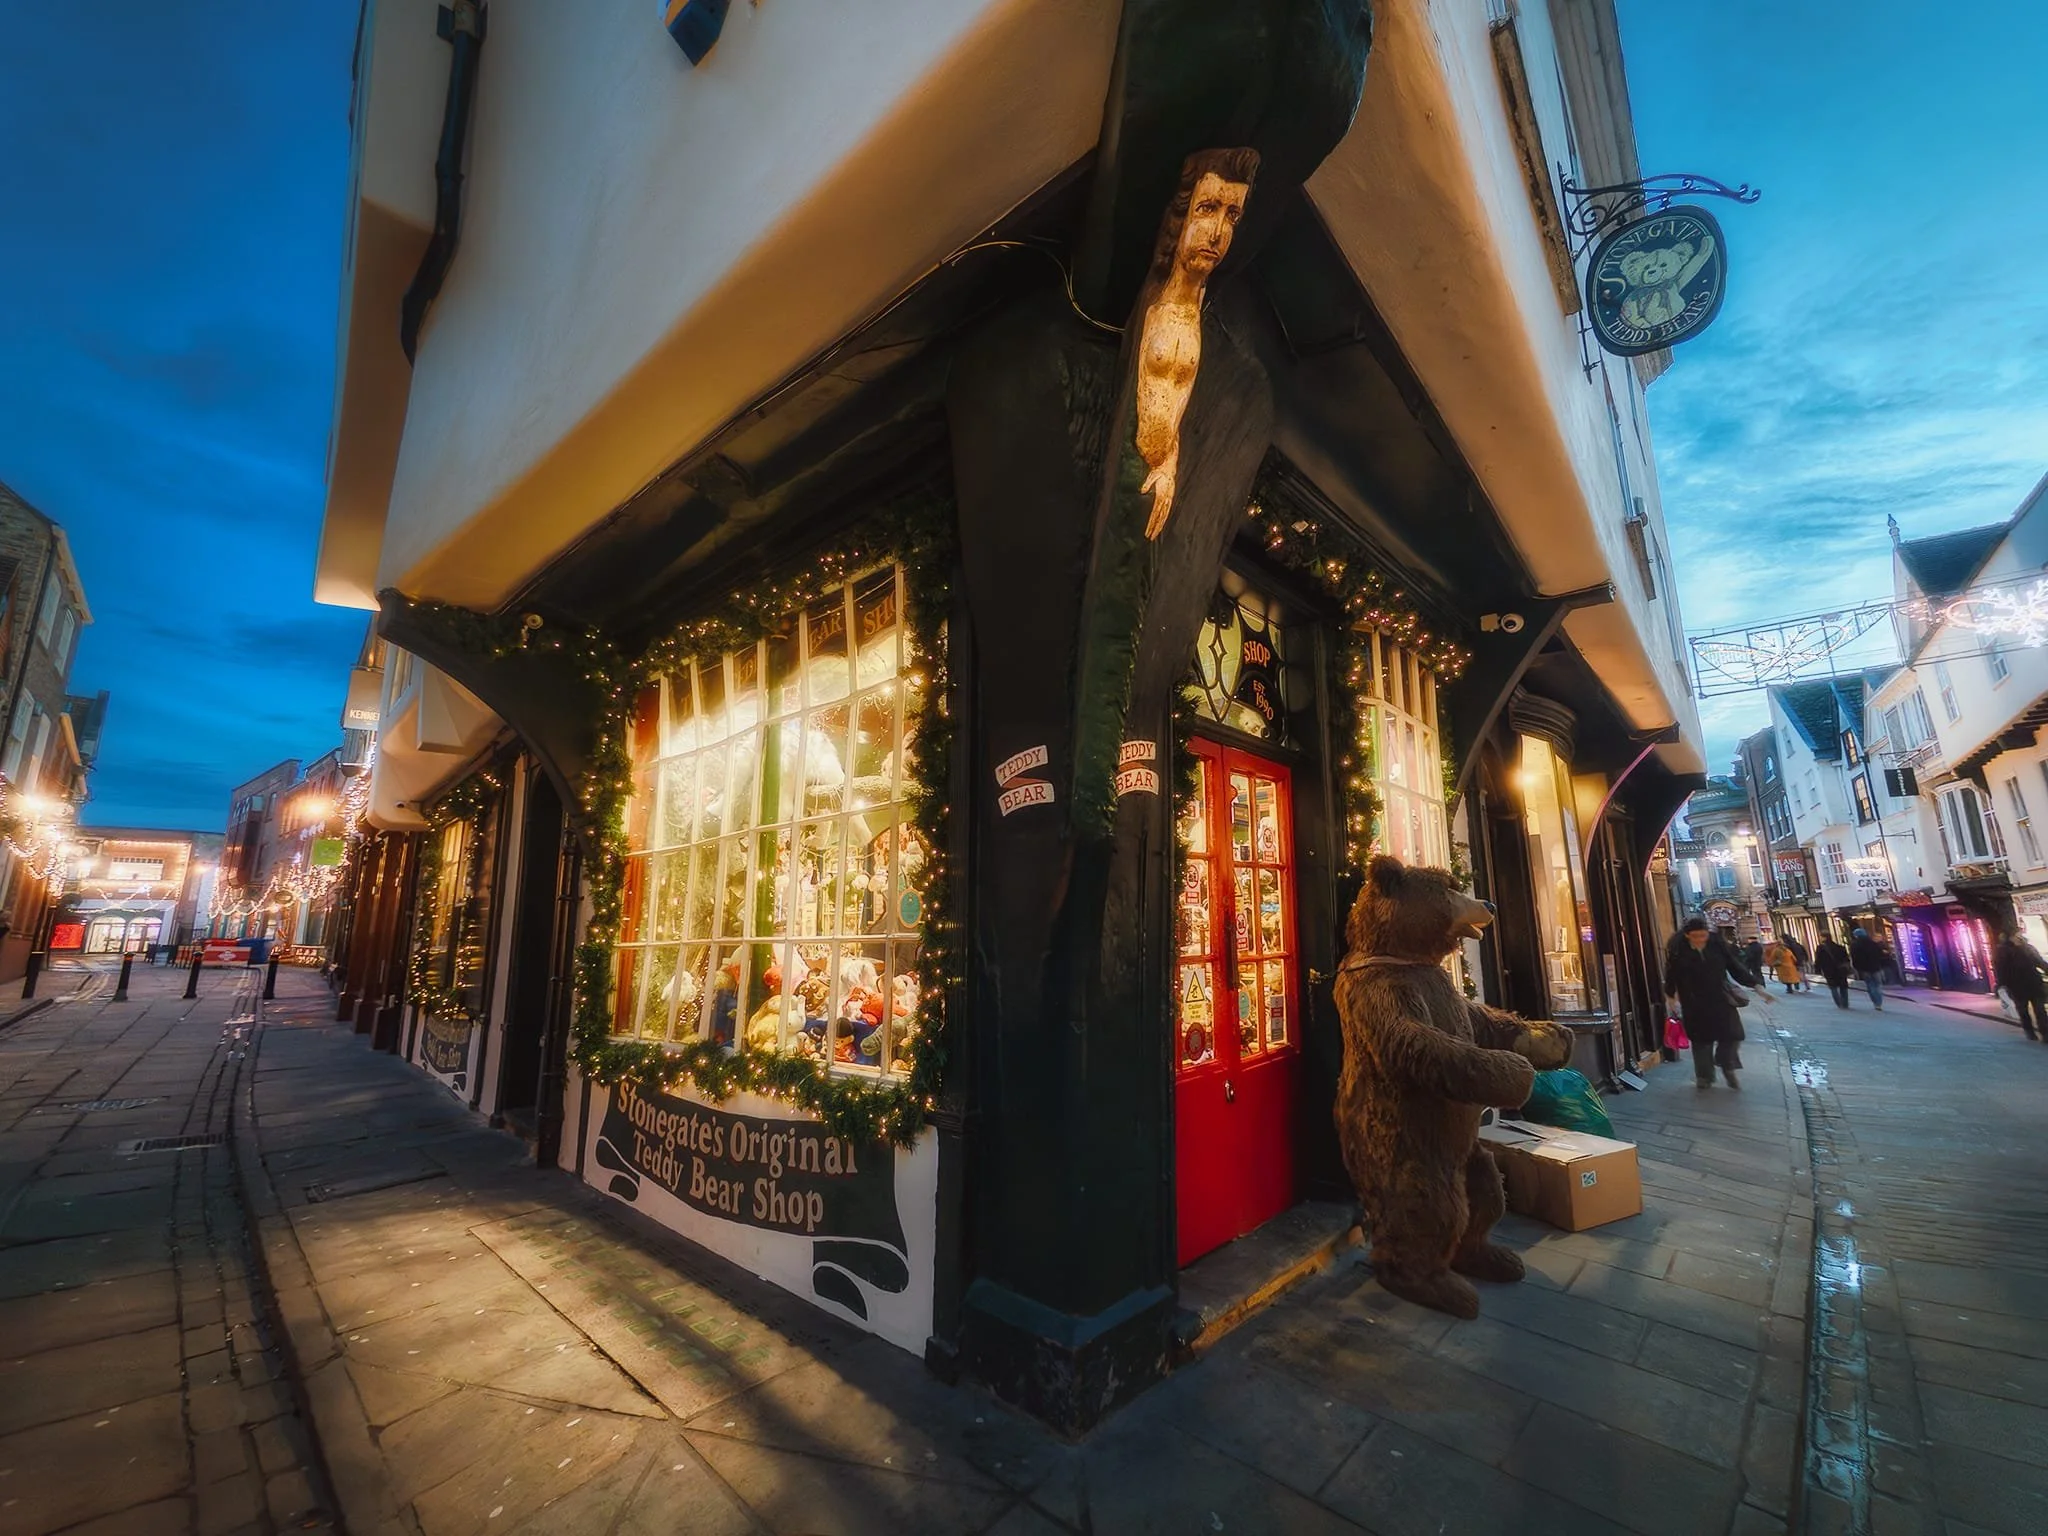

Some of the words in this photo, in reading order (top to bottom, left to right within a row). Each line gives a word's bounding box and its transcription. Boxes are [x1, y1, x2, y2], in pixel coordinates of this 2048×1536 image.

[1599, 221, 1700, 298] STONEGATE
[1607, 317, 1651, 341] TEDDY
[1662, 291, 1710, 336] BEARS
[1244, 640, 1271, 667] SHOP
[1256, 692, 1274, 720] 1990
[1000, 748, 1041, 779] TEDDY
[1120, 743, 1155, 762] TEDDY
[1115, 772, 1154, 792] BEAR
[1004, 785, 1046, 810] BEAR
[1858, 878, 1889, 888] CATS
[617, 1080, 724, 1158] Stonegate's
[730, 1121, 858, 1179] Original
[633, 1130, 684, 1193] Teddy
[689, 1156, 745, 1215] Bear
[752, 1177, 824, 1232] Shop
